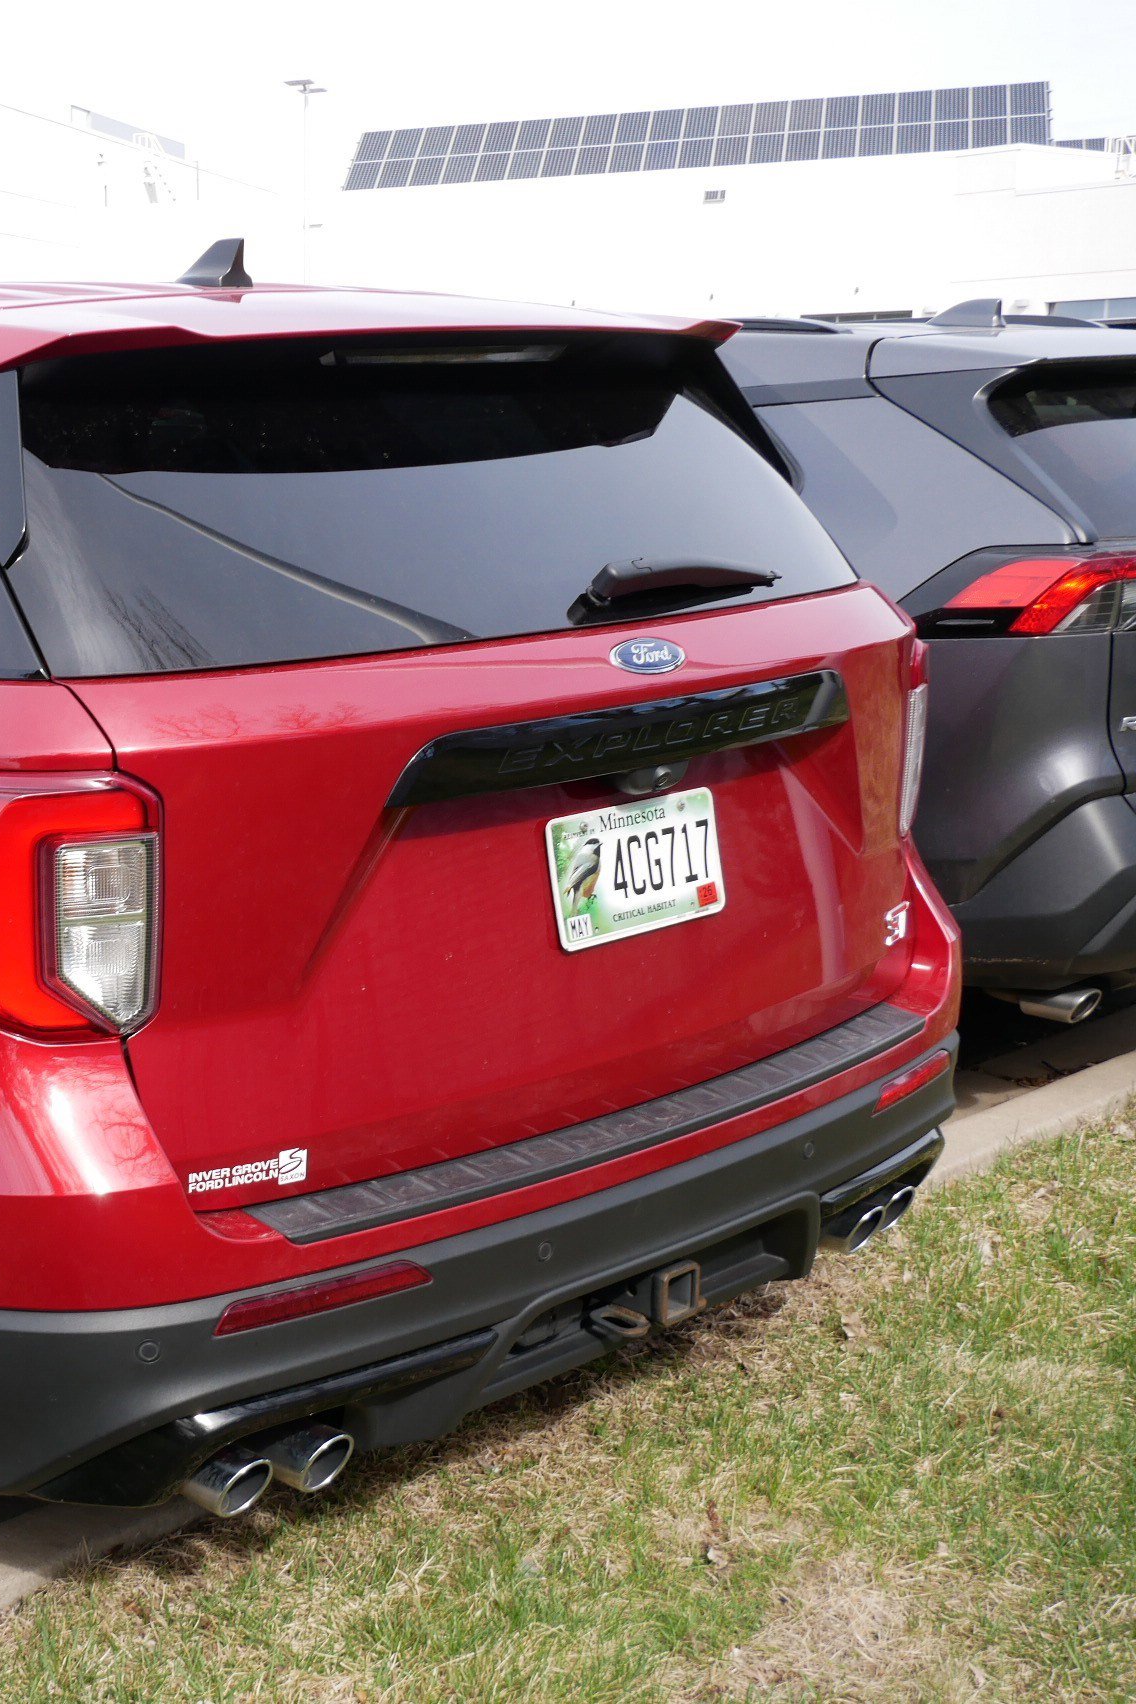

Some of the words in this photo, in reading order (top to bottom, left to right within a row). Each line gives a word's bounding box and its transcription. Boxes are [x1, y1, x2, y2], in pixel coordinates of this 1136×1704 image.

[630, 642, 672, 665] Ford
[497, 696, 801, 775] EXPLORER
[599, 807, 666, 833] Minnesota
[614, 818, 709, 898] 4CG717
[612, 908, 645, 922] CRITICAL
[647, 899, 677, 915] HABITAT
[571, 918, 591, 940] MAY
[189, 1168, 231, 1183] INVER
[232, 1158, 278, 1175] GROVE
[189, 1179, 224, 1193] FORD
[225, 1169, 278, 1187] LINCOLN
[280, 1172, 305, 1182] SAXON
